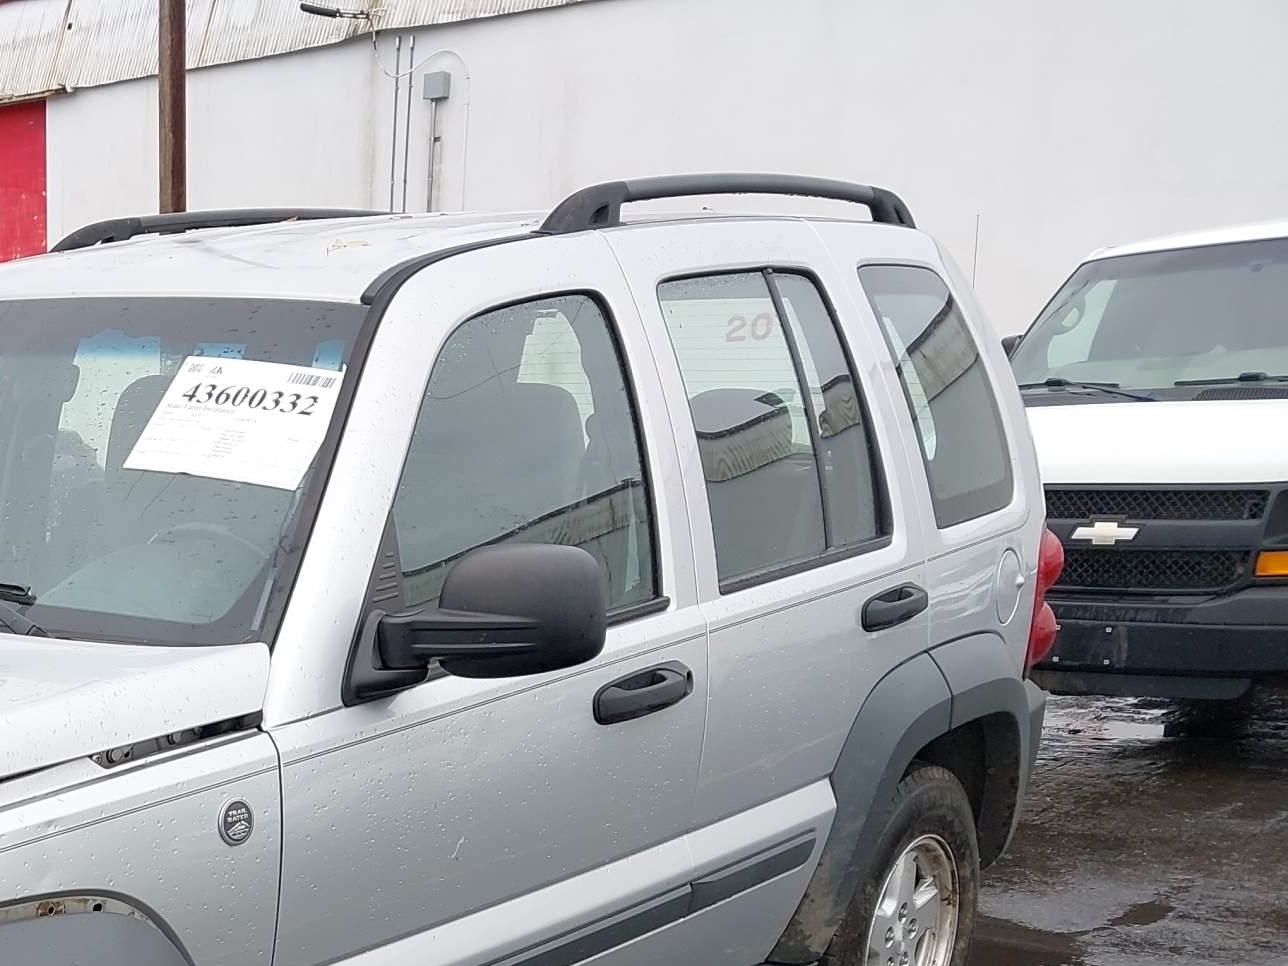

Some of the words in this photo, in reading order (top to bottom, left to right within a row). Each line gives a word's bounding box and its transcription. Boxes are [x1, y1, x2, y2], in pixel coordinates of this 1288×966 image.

[182, 382, 319, 416] 43600332
[228, 808, 247, 817] TRAIL
[227, 814, 249, 823] RATED
